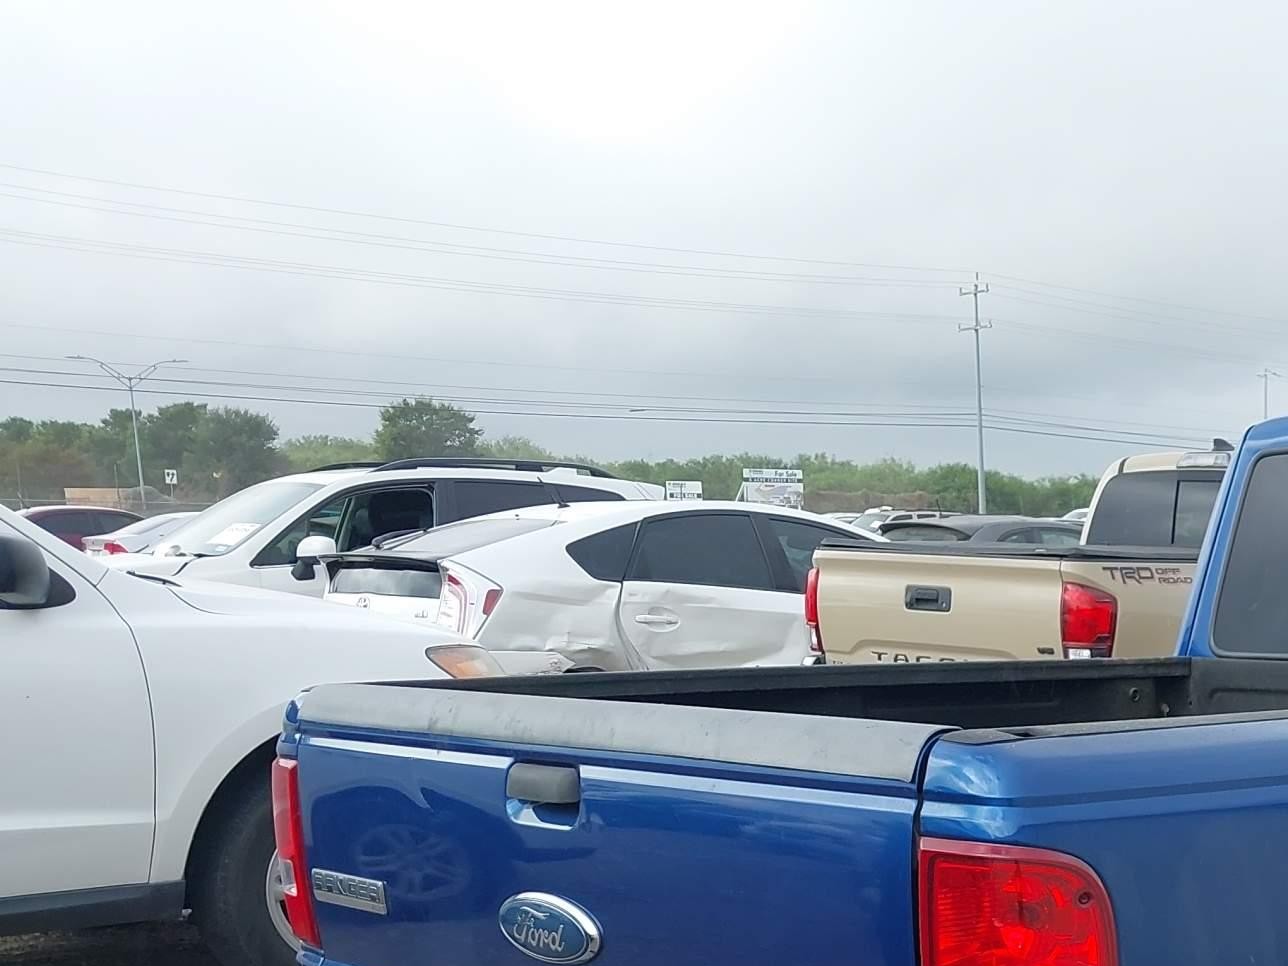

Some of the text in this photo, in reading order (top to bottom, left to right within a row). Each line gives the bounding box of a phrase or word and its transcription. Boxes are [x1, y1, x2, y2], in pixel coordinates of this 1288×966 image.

[1102, 566, 1154, 584] TRD
[1155, 567, 1180, 575] OFF
[1158, 576, 1193, 584] ROAD
[513, 906, 566, 952] Ford
